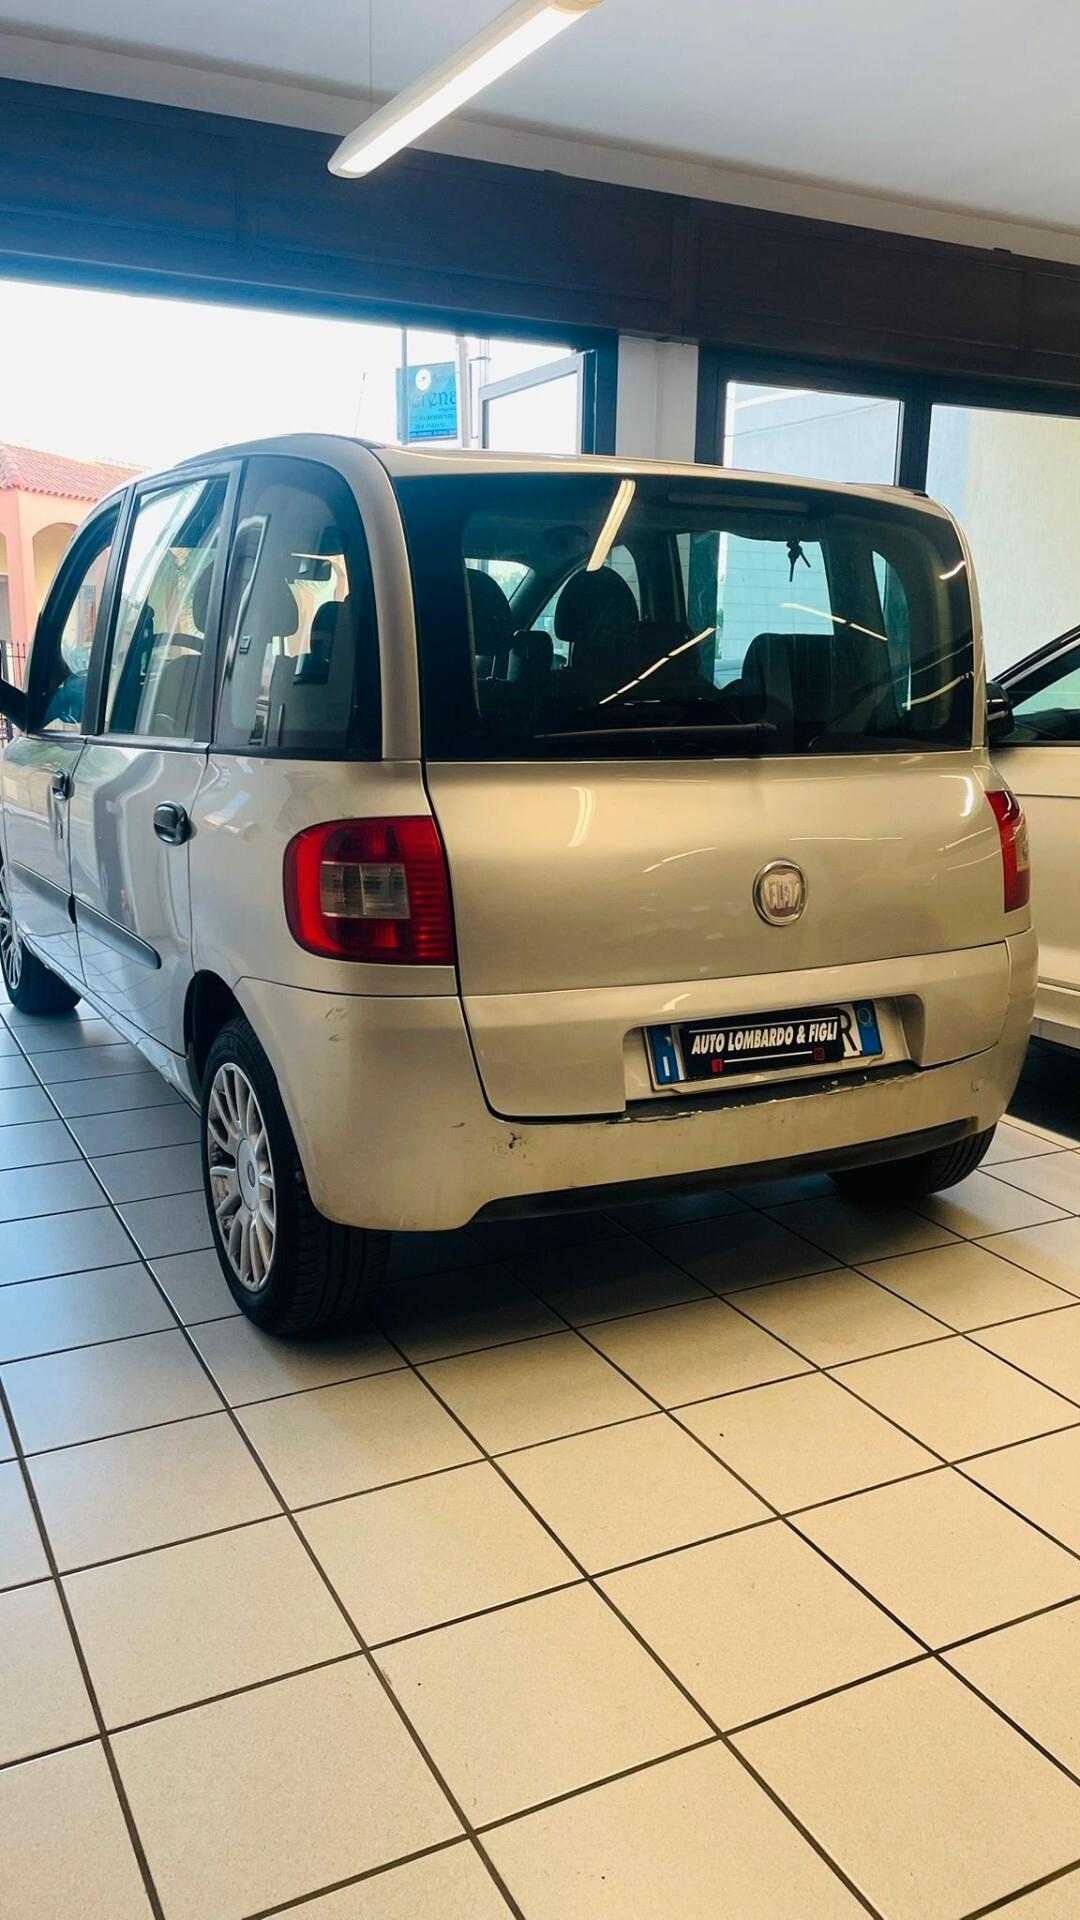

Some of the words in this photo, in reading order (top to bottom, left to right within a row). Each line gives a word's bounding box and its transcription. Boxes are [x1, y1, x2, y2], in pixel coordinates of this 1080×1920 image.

[764, 876, 800, 909] FIAT
[691, 1033, 724, 1055] AUTO
[727, 1024, 793, 1051] LOMBARDO
[796, 1026, 806, 1044] &
[808, 1020, 839, 1043] FIGLI
